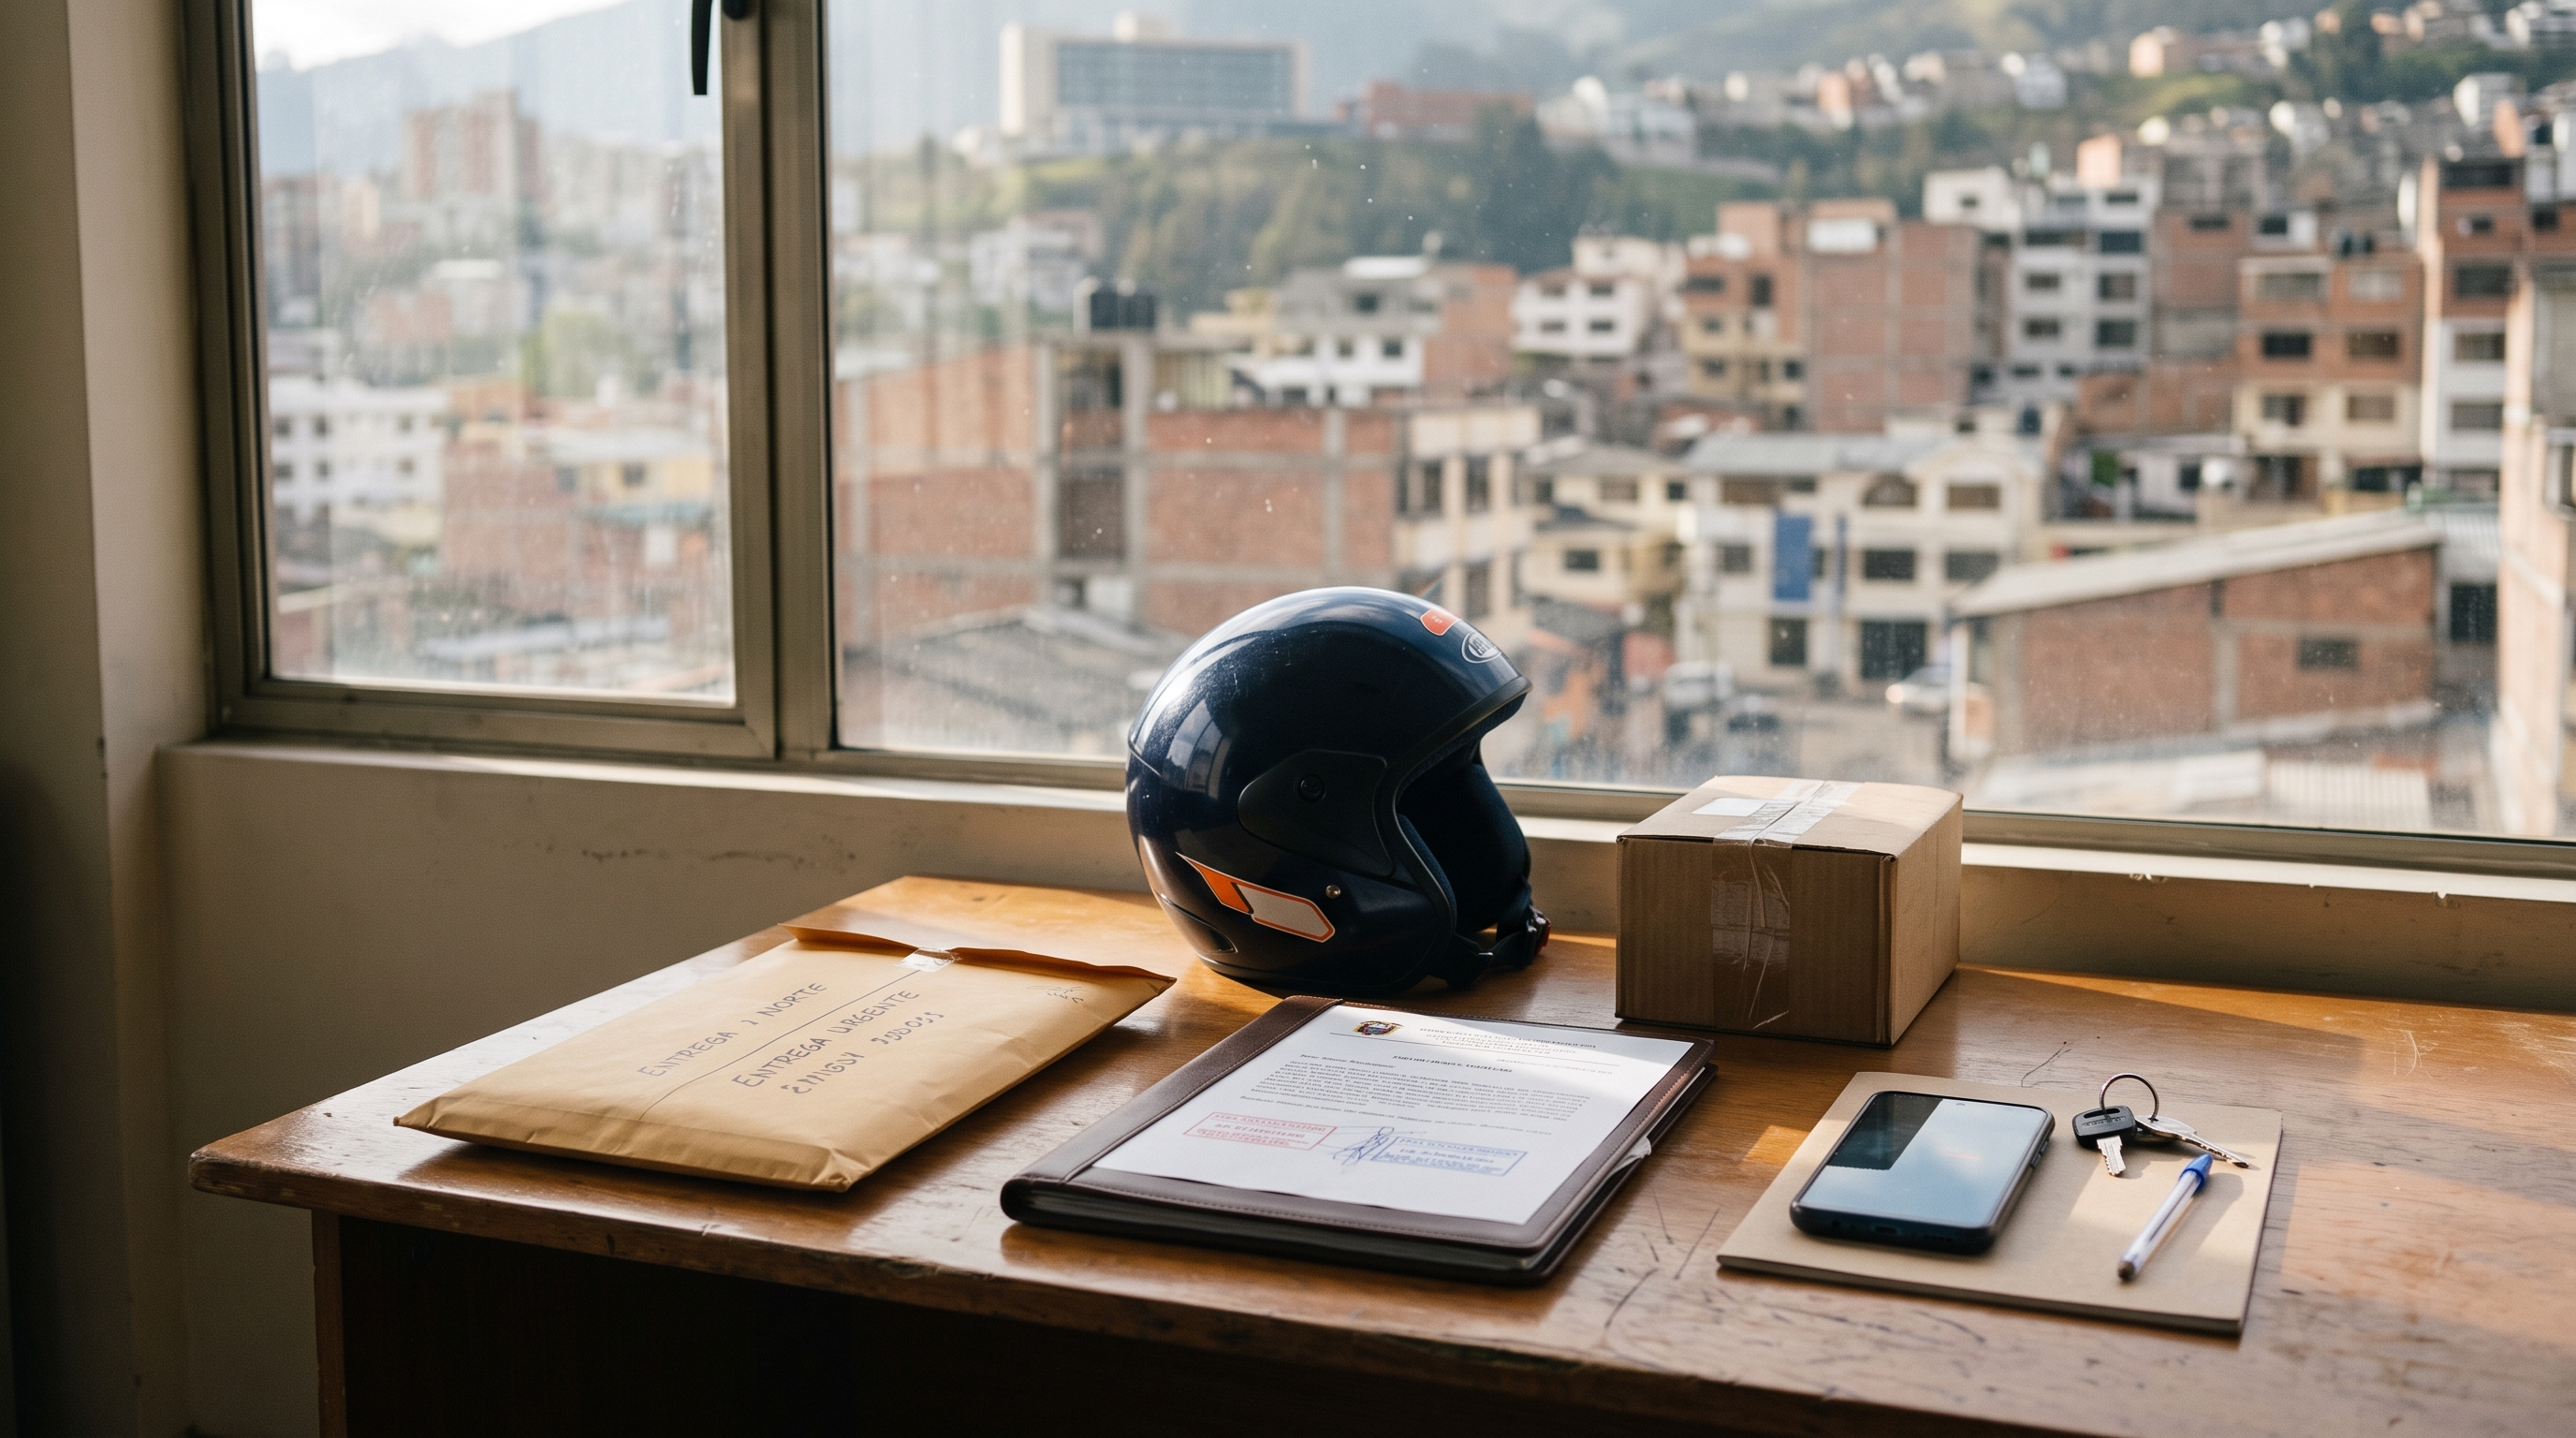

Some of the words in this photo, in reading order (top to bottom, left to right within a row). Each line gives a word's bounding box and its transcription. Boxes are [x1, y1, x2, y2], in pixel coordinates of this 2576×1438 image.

[637, 1030, 739, 1077] ENTREGA
[756, 982, 827, 1018] NORTE
[731, 1036, 832, 1088] ENTREGA
[827, 990, 920, 1034] URGENTE
